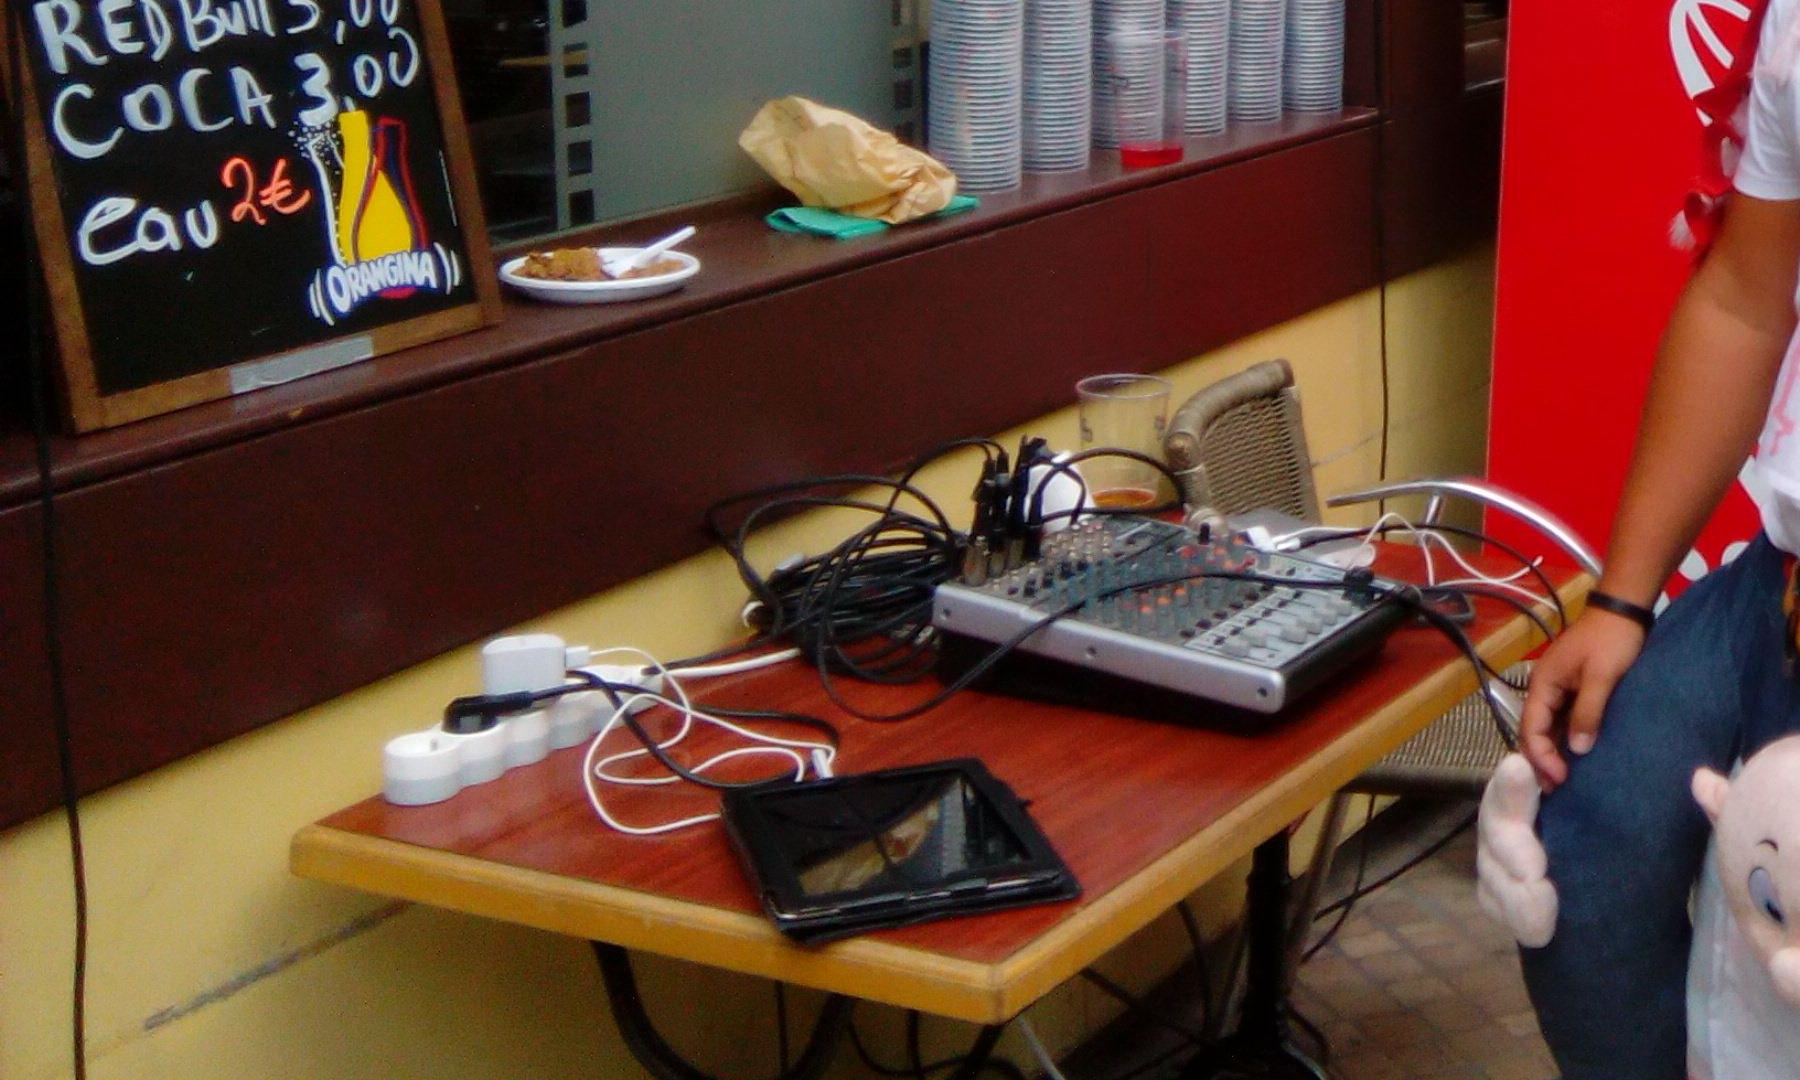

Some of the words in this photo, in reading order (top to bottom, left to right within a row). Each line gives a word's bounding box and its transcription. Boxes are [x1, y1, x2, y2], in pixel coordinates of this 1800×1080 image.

[53, 66, 277, 159] COCA
[294, 26, 419, 126] 3,00
[326, 250, 438, 313] ORANGINA
